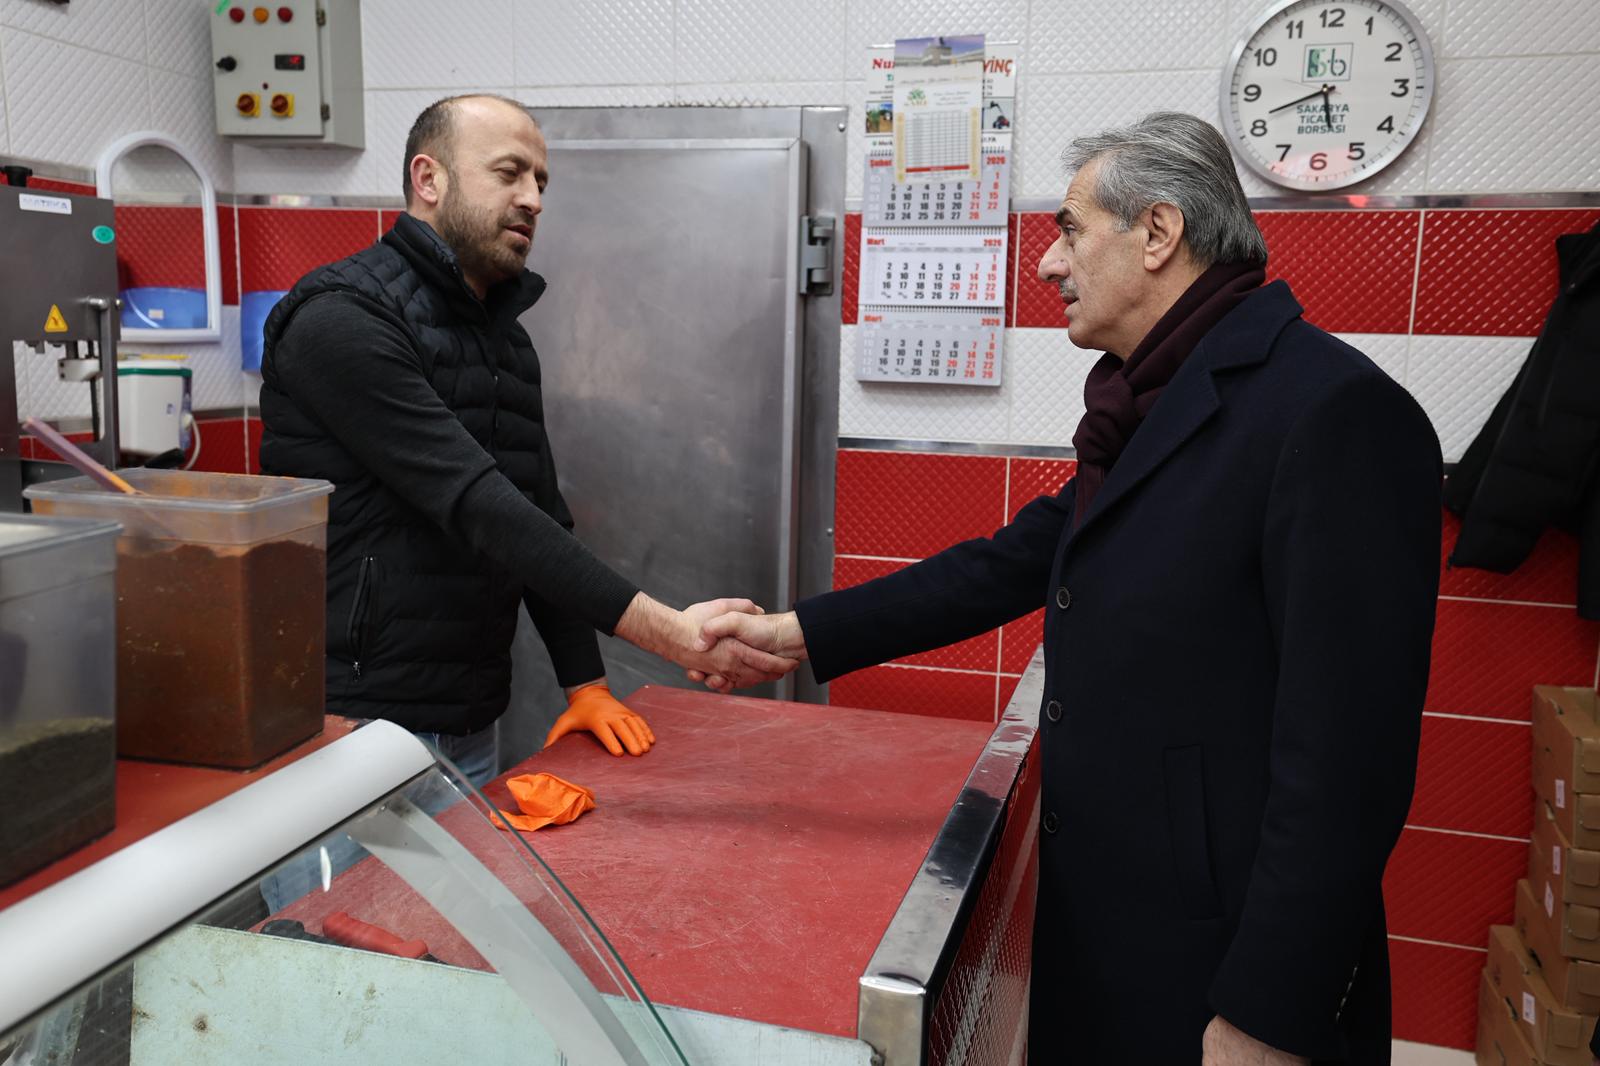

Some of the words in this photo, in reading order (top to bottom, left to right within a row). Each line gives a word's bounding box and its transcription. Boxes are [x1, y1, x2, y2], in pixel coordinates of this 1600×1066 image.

[1319, 8, 1345, 28] 12
[1365, 17, 1373, 35] 1
[1286, 20, 1303, 39] 11
[1254, 48, 1277, 67] 10
[1385, 43, 1403, 62] 2
[1244, 84, 1261, 102] 9
[1391, 79, 1409, 97] 3
[1297, 104, 1350, 113] SAKARYA
[1250, 119, 1267, 136] 8
[1300, 114, 1345, 124] TİCAET
[1377, 116, 1394, 134] 4
[1298, 125, 1345, 134] BORSASI
[1276, 144, 1292, 162] 7
[1347, 143, 1364, 160] 5
[1310, 153, 1328, 170] 6
[914, 291, 924, 299] 25
[932, 292, 942, 300] 26
